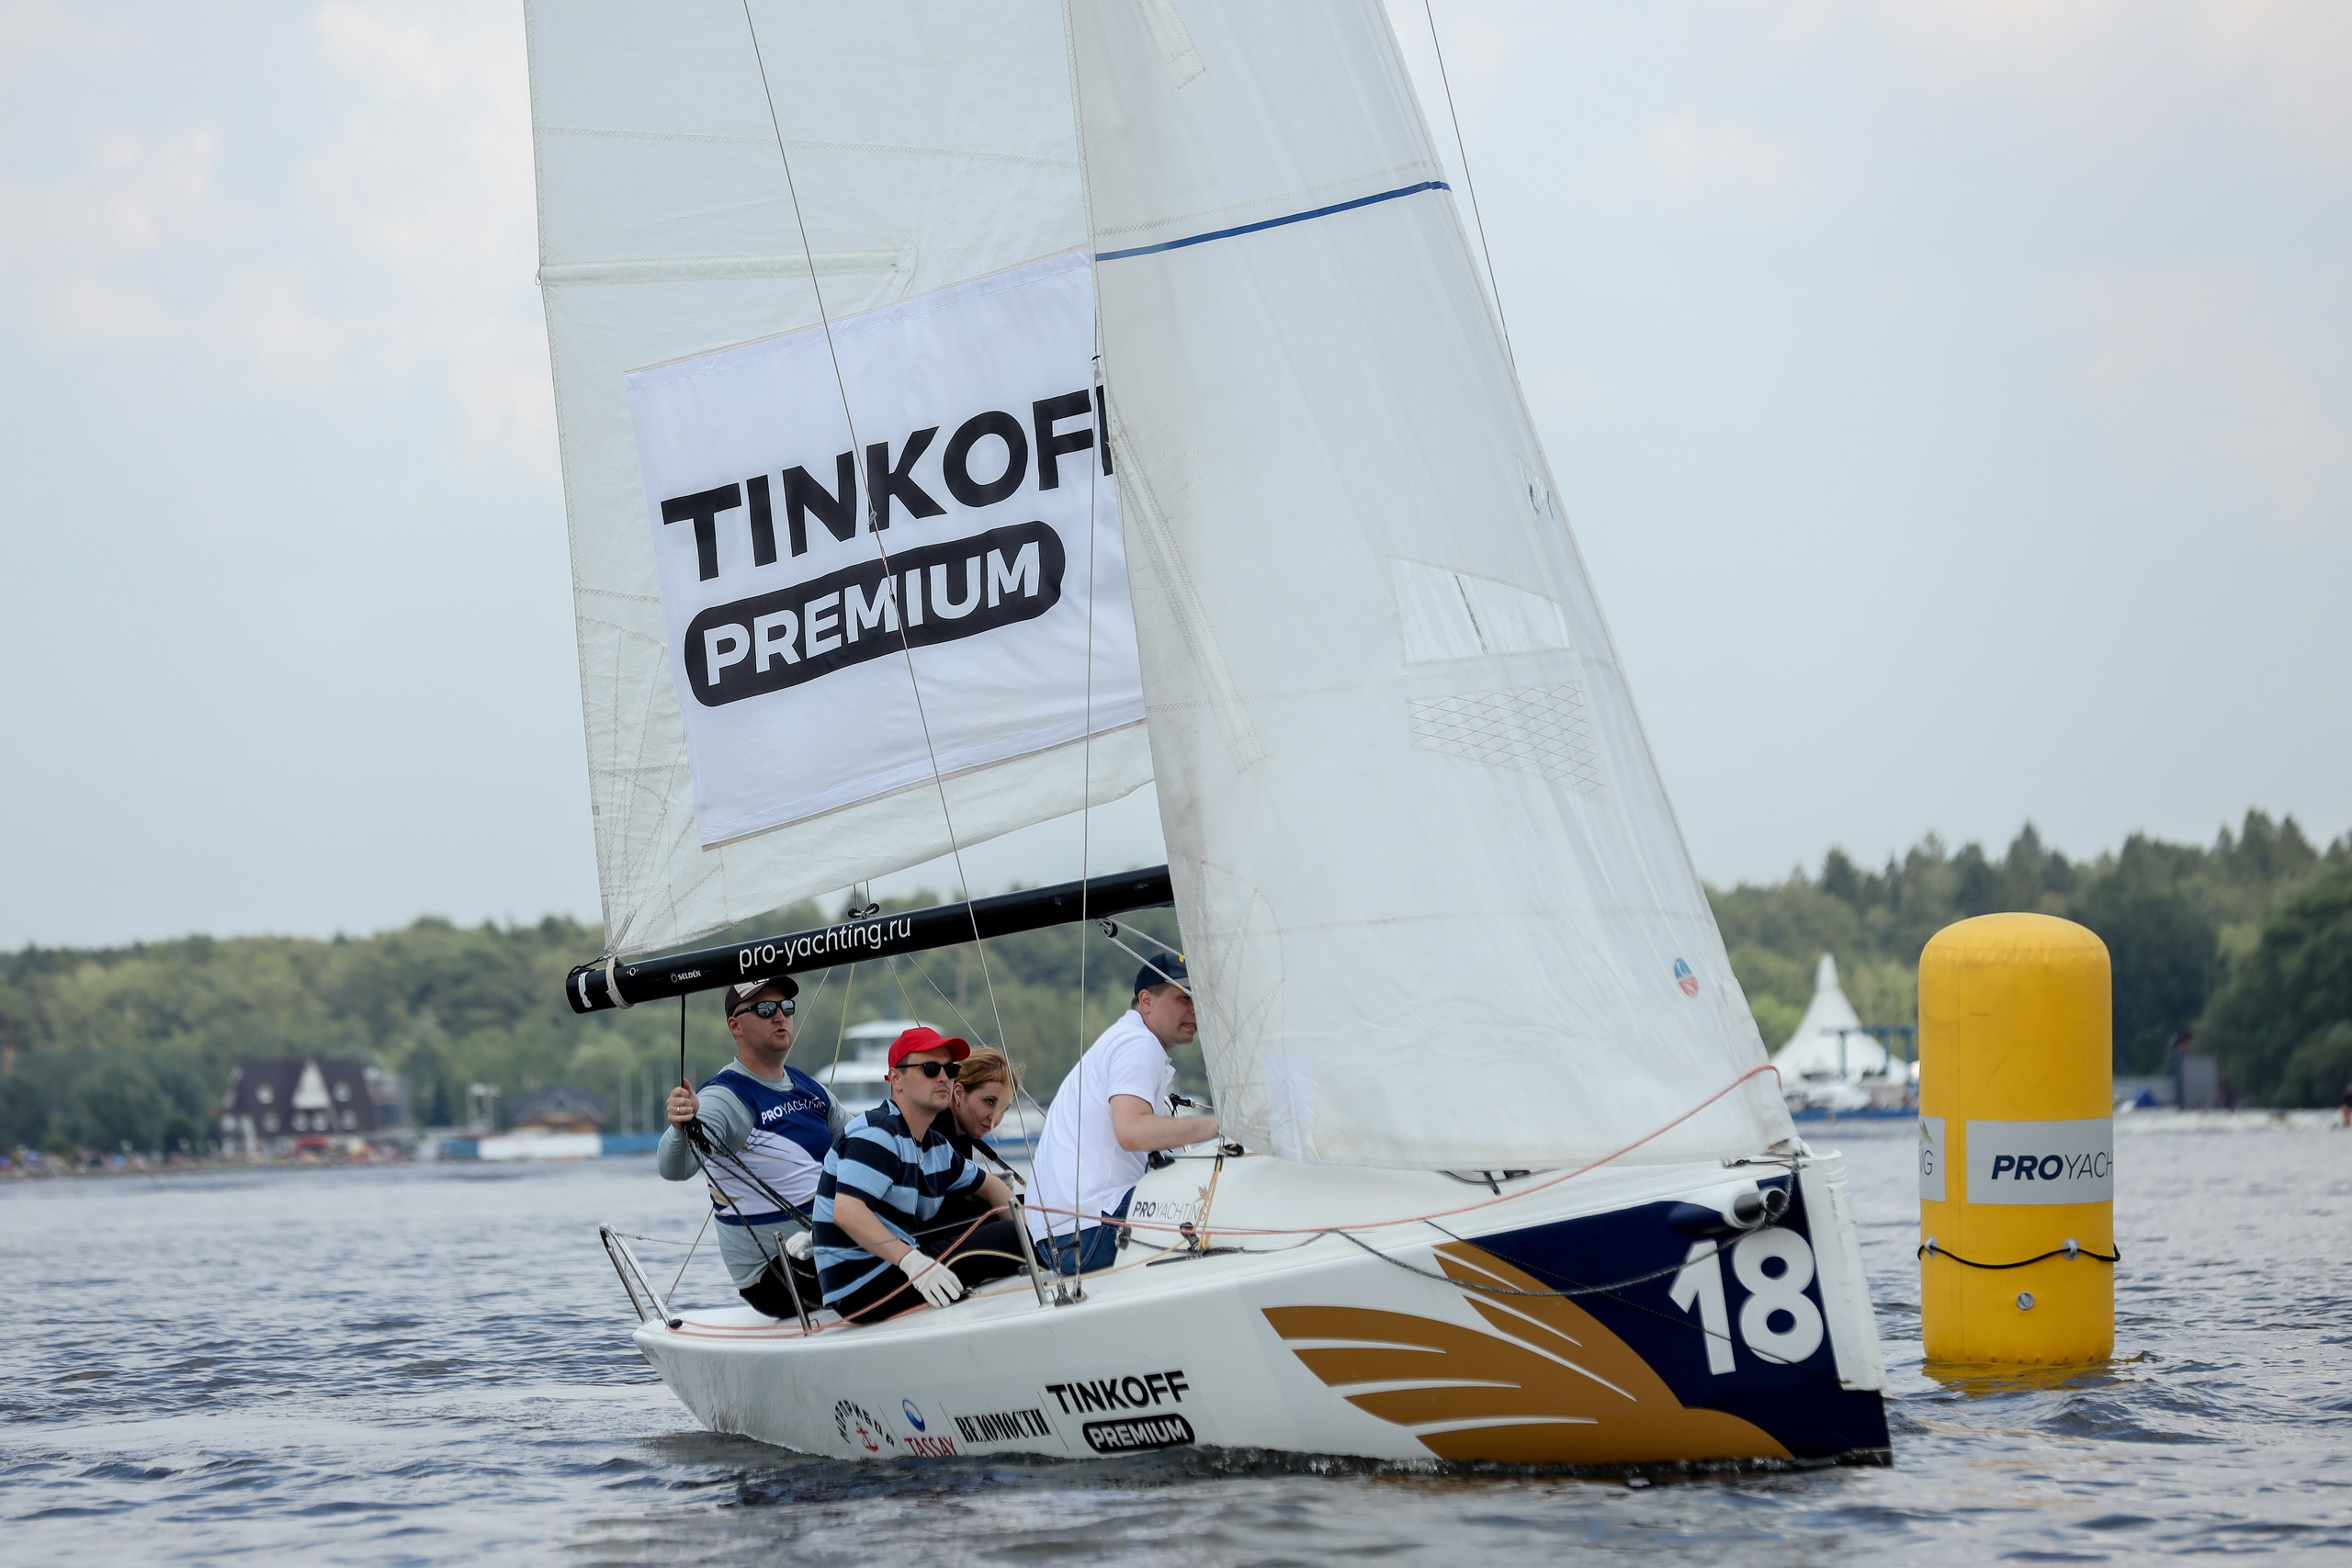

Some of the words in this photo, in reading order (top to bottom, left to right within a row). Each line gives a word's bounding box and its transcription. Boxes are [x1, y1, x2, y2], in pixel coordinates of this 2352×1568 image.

[704, 542, 1041, 687] PREMIUM
[739, 918, 911, 975] pro-yachting.ru
[1668, 1227, 1824, 1375] 18
[1045, 1370, 1190, 1415] TINKOFF
[904, 1437, 957, 1457] TASSAY
[954, 1409, 1052, 1446] ВЕДОМОСТИ
[1088, 1419, 1189, 1449] PREMIUM
